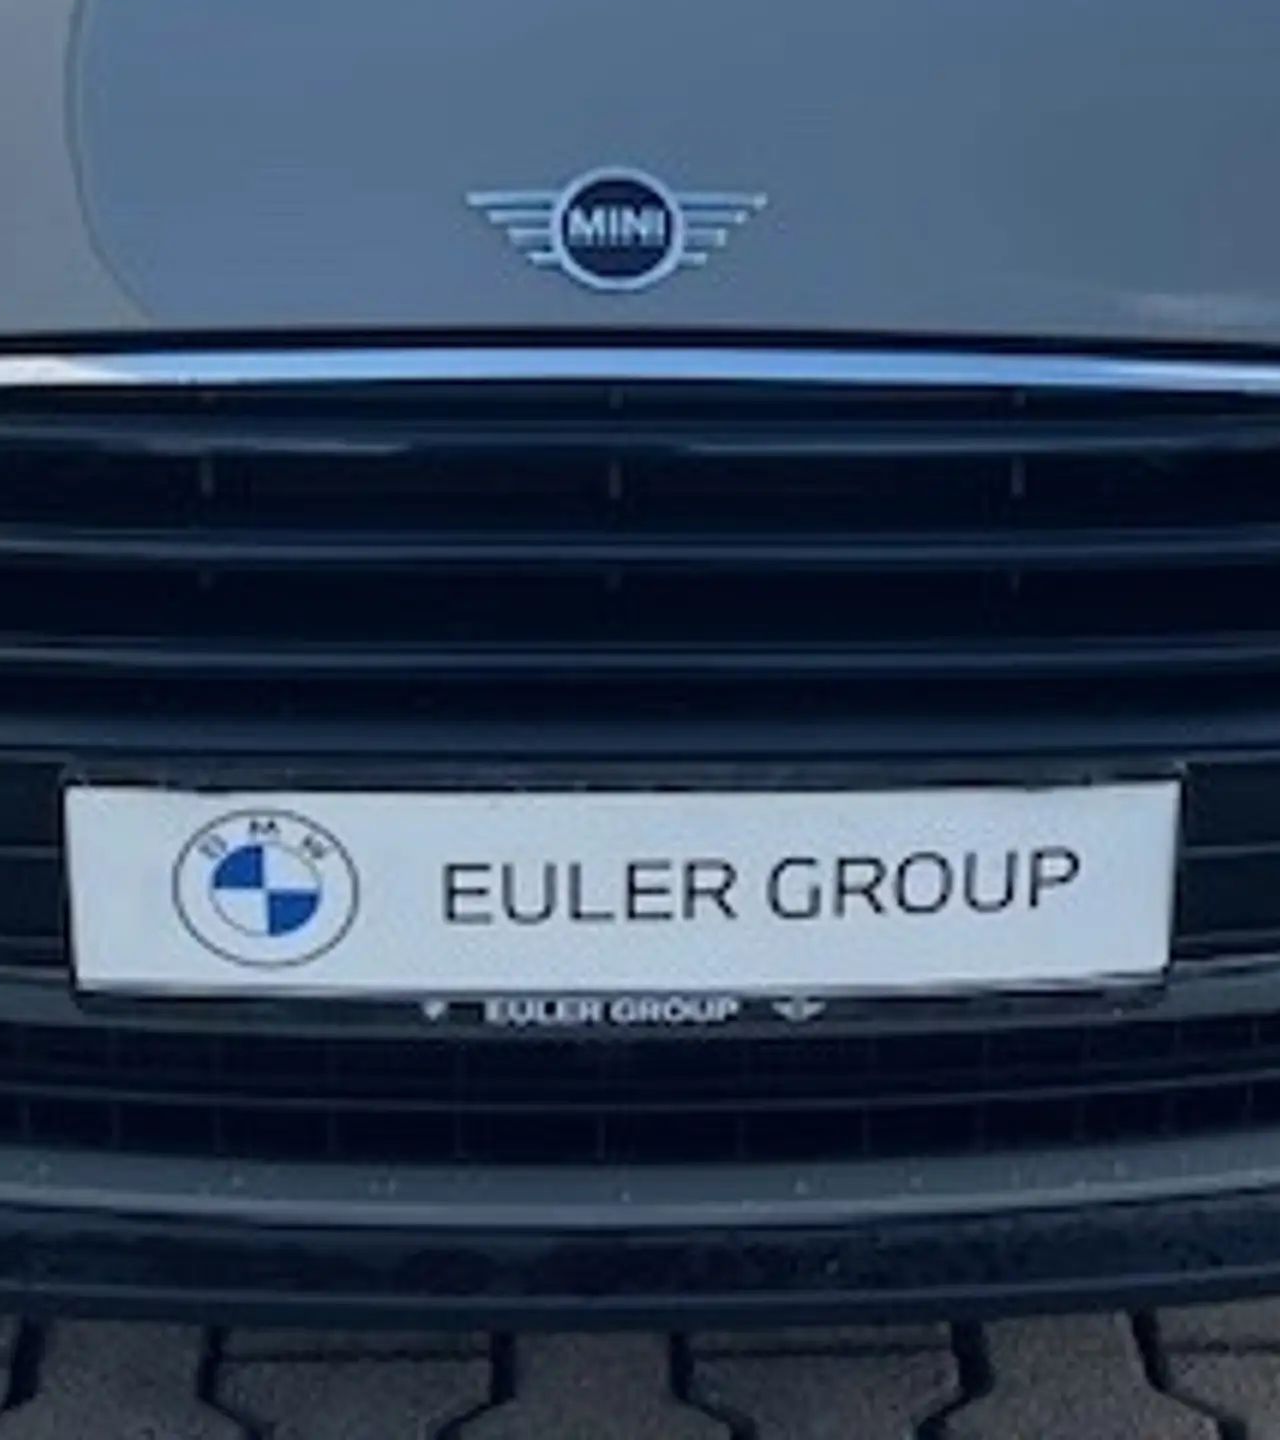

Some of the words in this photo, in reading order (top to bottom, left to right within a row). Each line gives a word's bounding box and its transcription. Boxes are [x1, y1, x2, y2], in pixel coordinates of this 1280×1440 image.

[569, 205, 665, 246] MINI
[442, 859, 739, 926] EULER
[767, 846, 1080, 920] GROUP
[484, 996, 604, 1025] EULER
[609, 996, 740, 1024] GROUP
